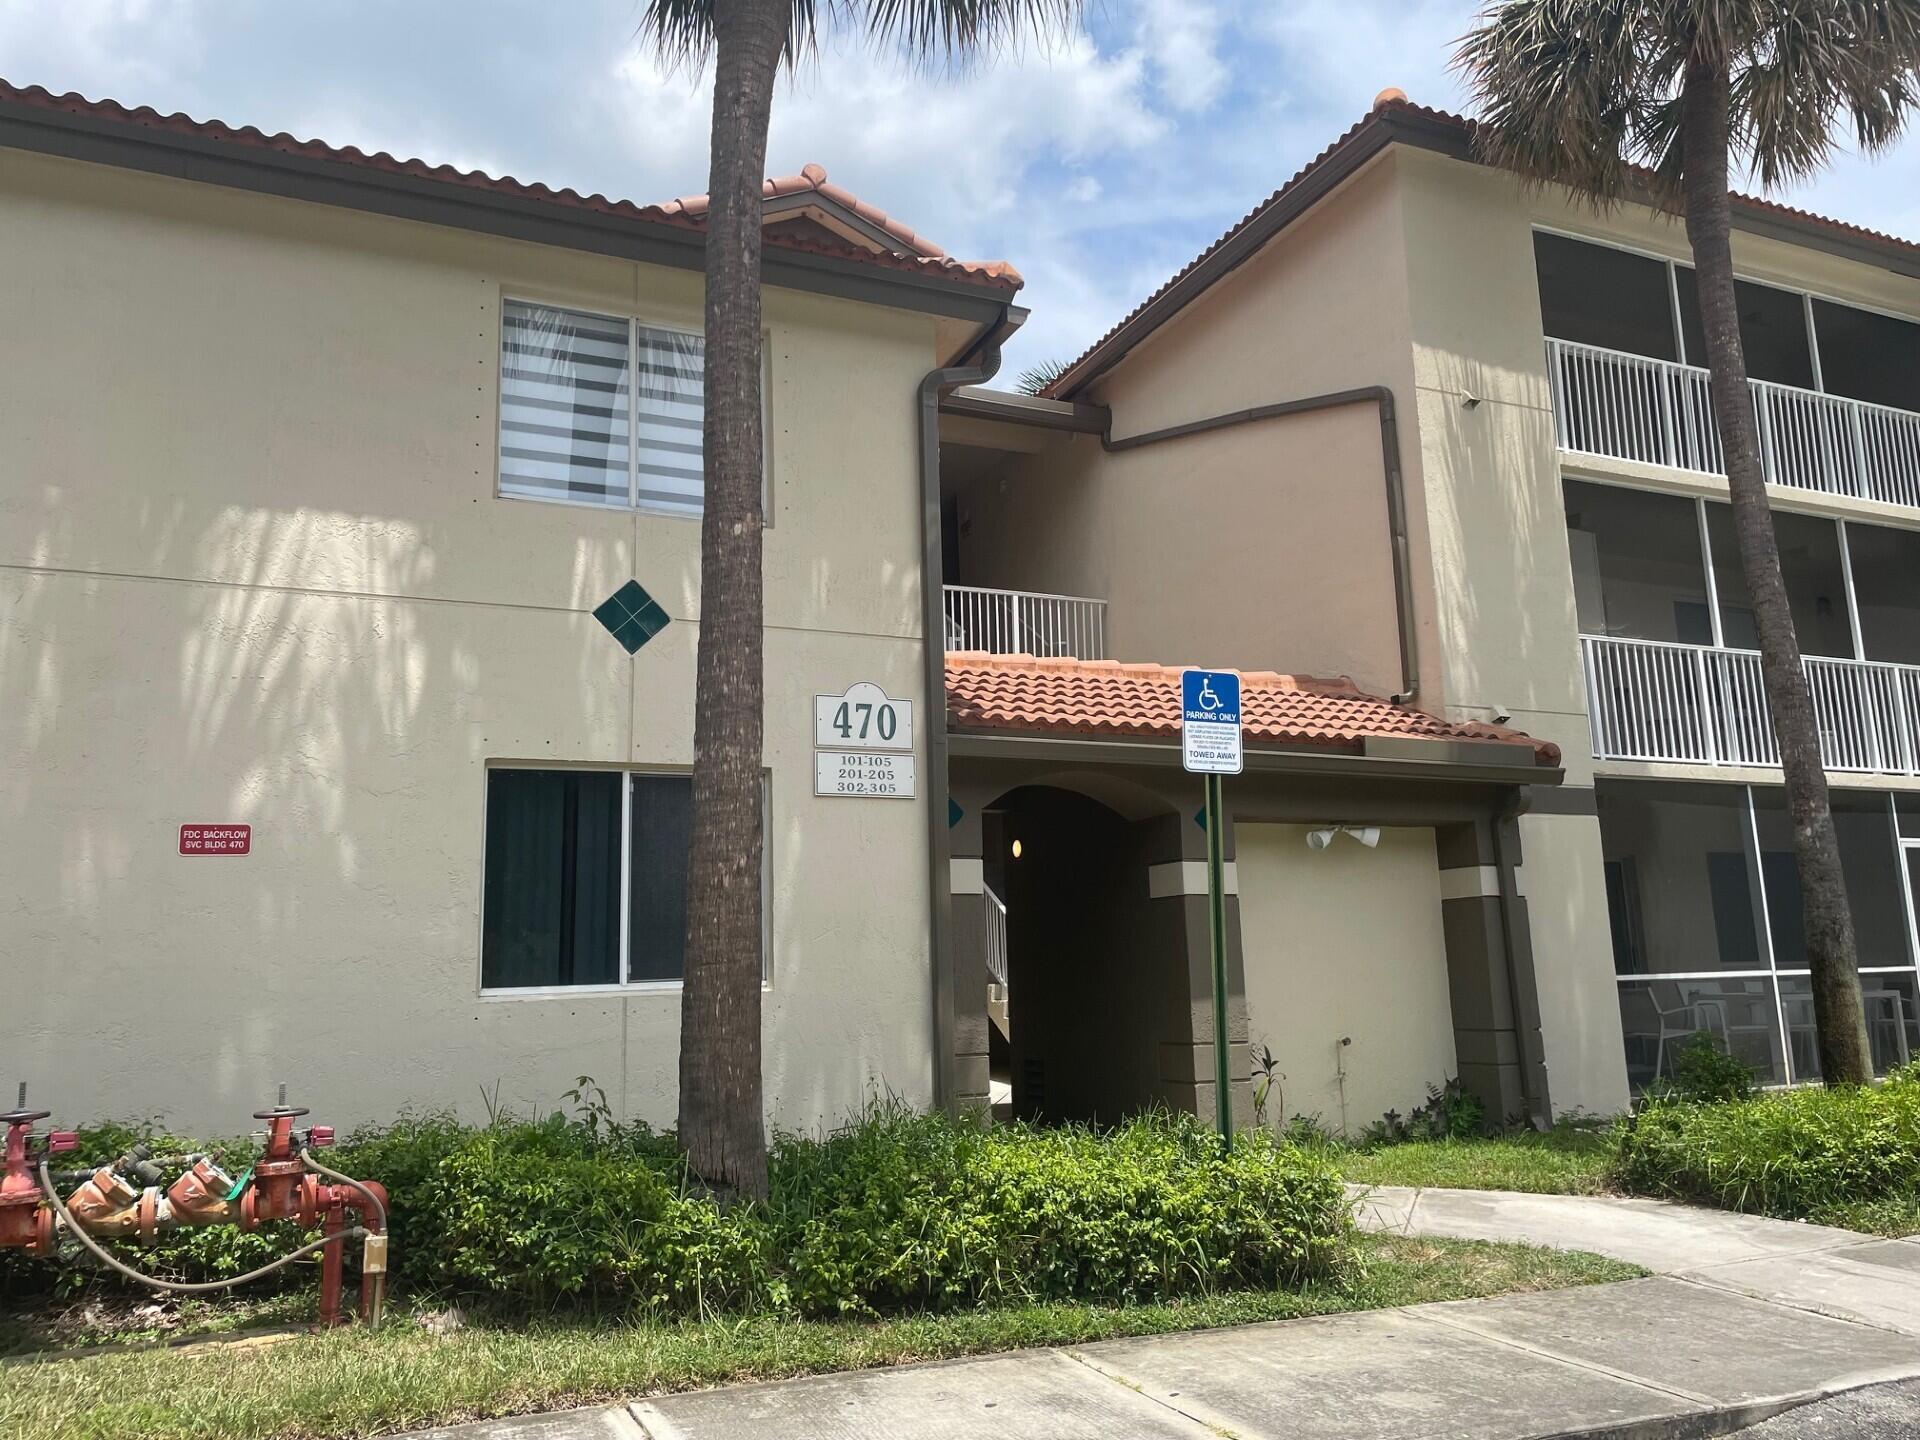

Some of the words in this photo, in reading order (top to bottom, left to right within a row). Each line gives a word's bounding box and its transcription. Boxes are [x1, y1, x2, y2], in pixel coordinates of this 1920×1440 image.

[833, 701, 897, 741] 470
[1186, 710, 1217, 721] PARKING
[1219, 712, 1237, 722] ONLY
[1189, 750, 1215, 759] TOWED
[1216, 751, 1236, 760] AWAY
[841, 756, 892, 767] 101-105
[839, 769, 895, 780] 201-205
[837, 782, 896, 793] 302-305
[183, 830, 201, 839] FDC
[203, 830, 248, 839] BACKFLOW
[185, 840, 202, 848] SVC
[204, 840, 227, 848] BLDG
[229, 840, 244, 848] 470
